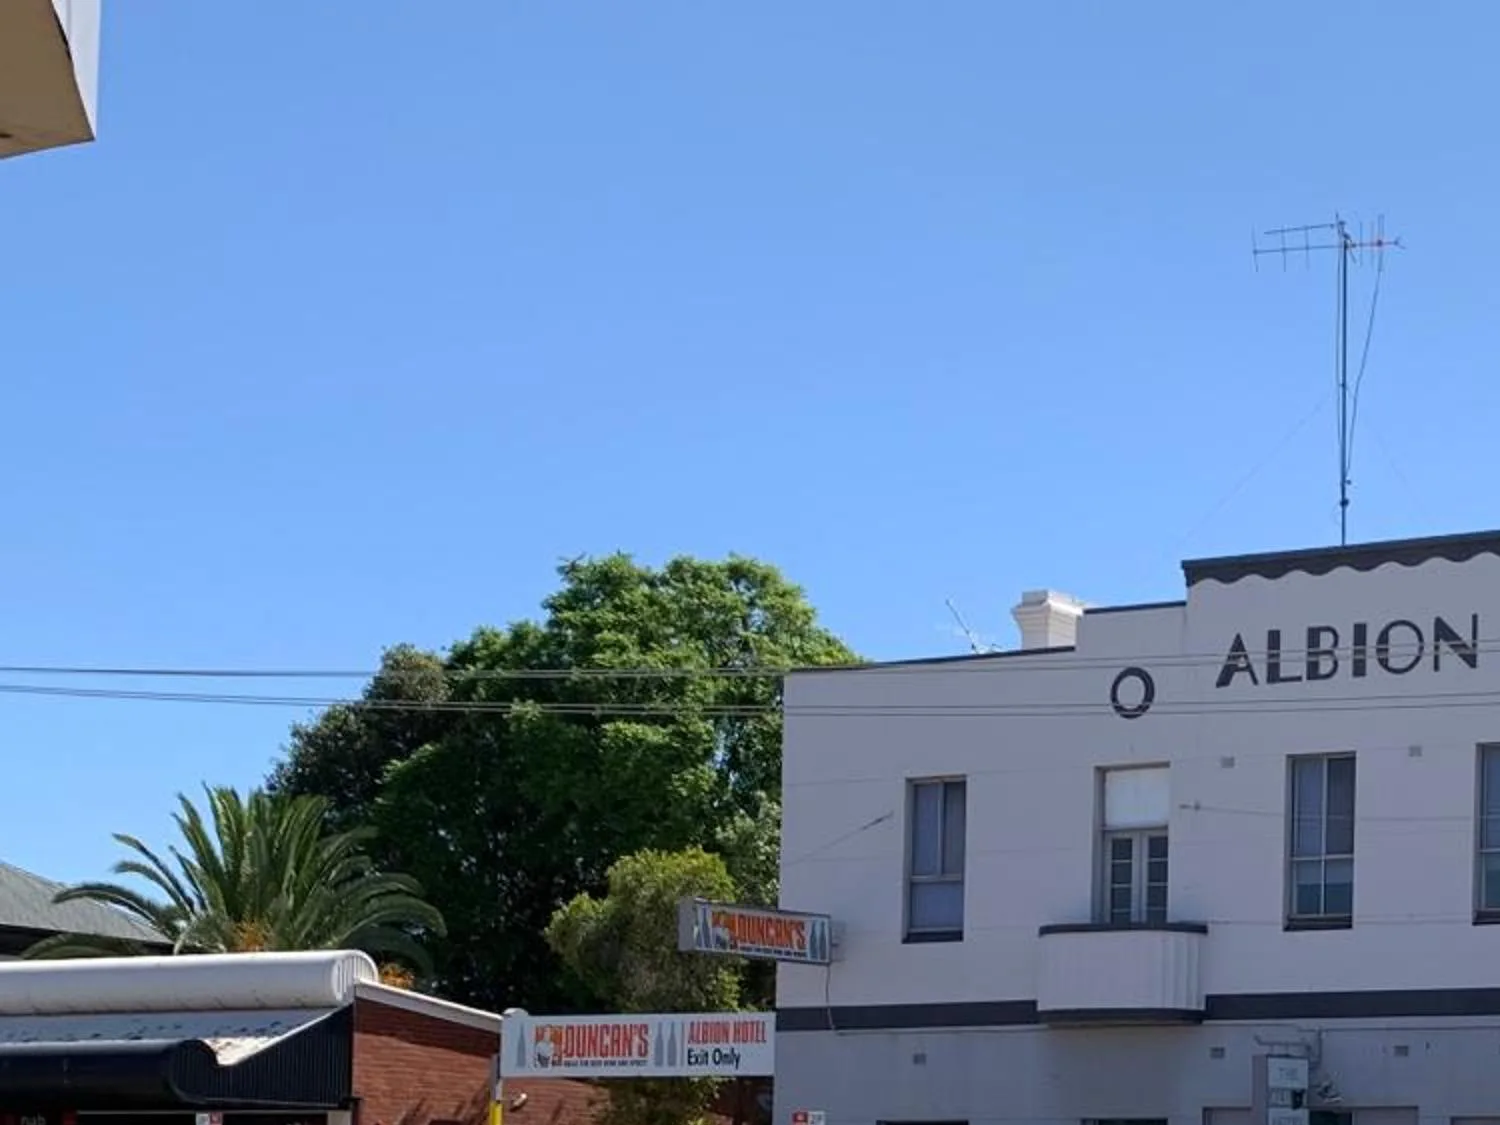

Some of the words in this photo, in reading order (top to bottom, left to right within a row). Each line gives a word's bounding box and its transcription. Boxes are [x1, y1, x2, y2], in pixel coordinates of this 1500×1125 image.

[1215, 612, 1478, 689] ALBION
[564, 1023, 649, 1058] DUNCAN'S
[687, 1021, 730, 1044] ALBION
[732, 1020, 767, 1044] HOTEL
[687, 1048, 709, 1066] Exit
[712, 1047, 741, 1070] Only
